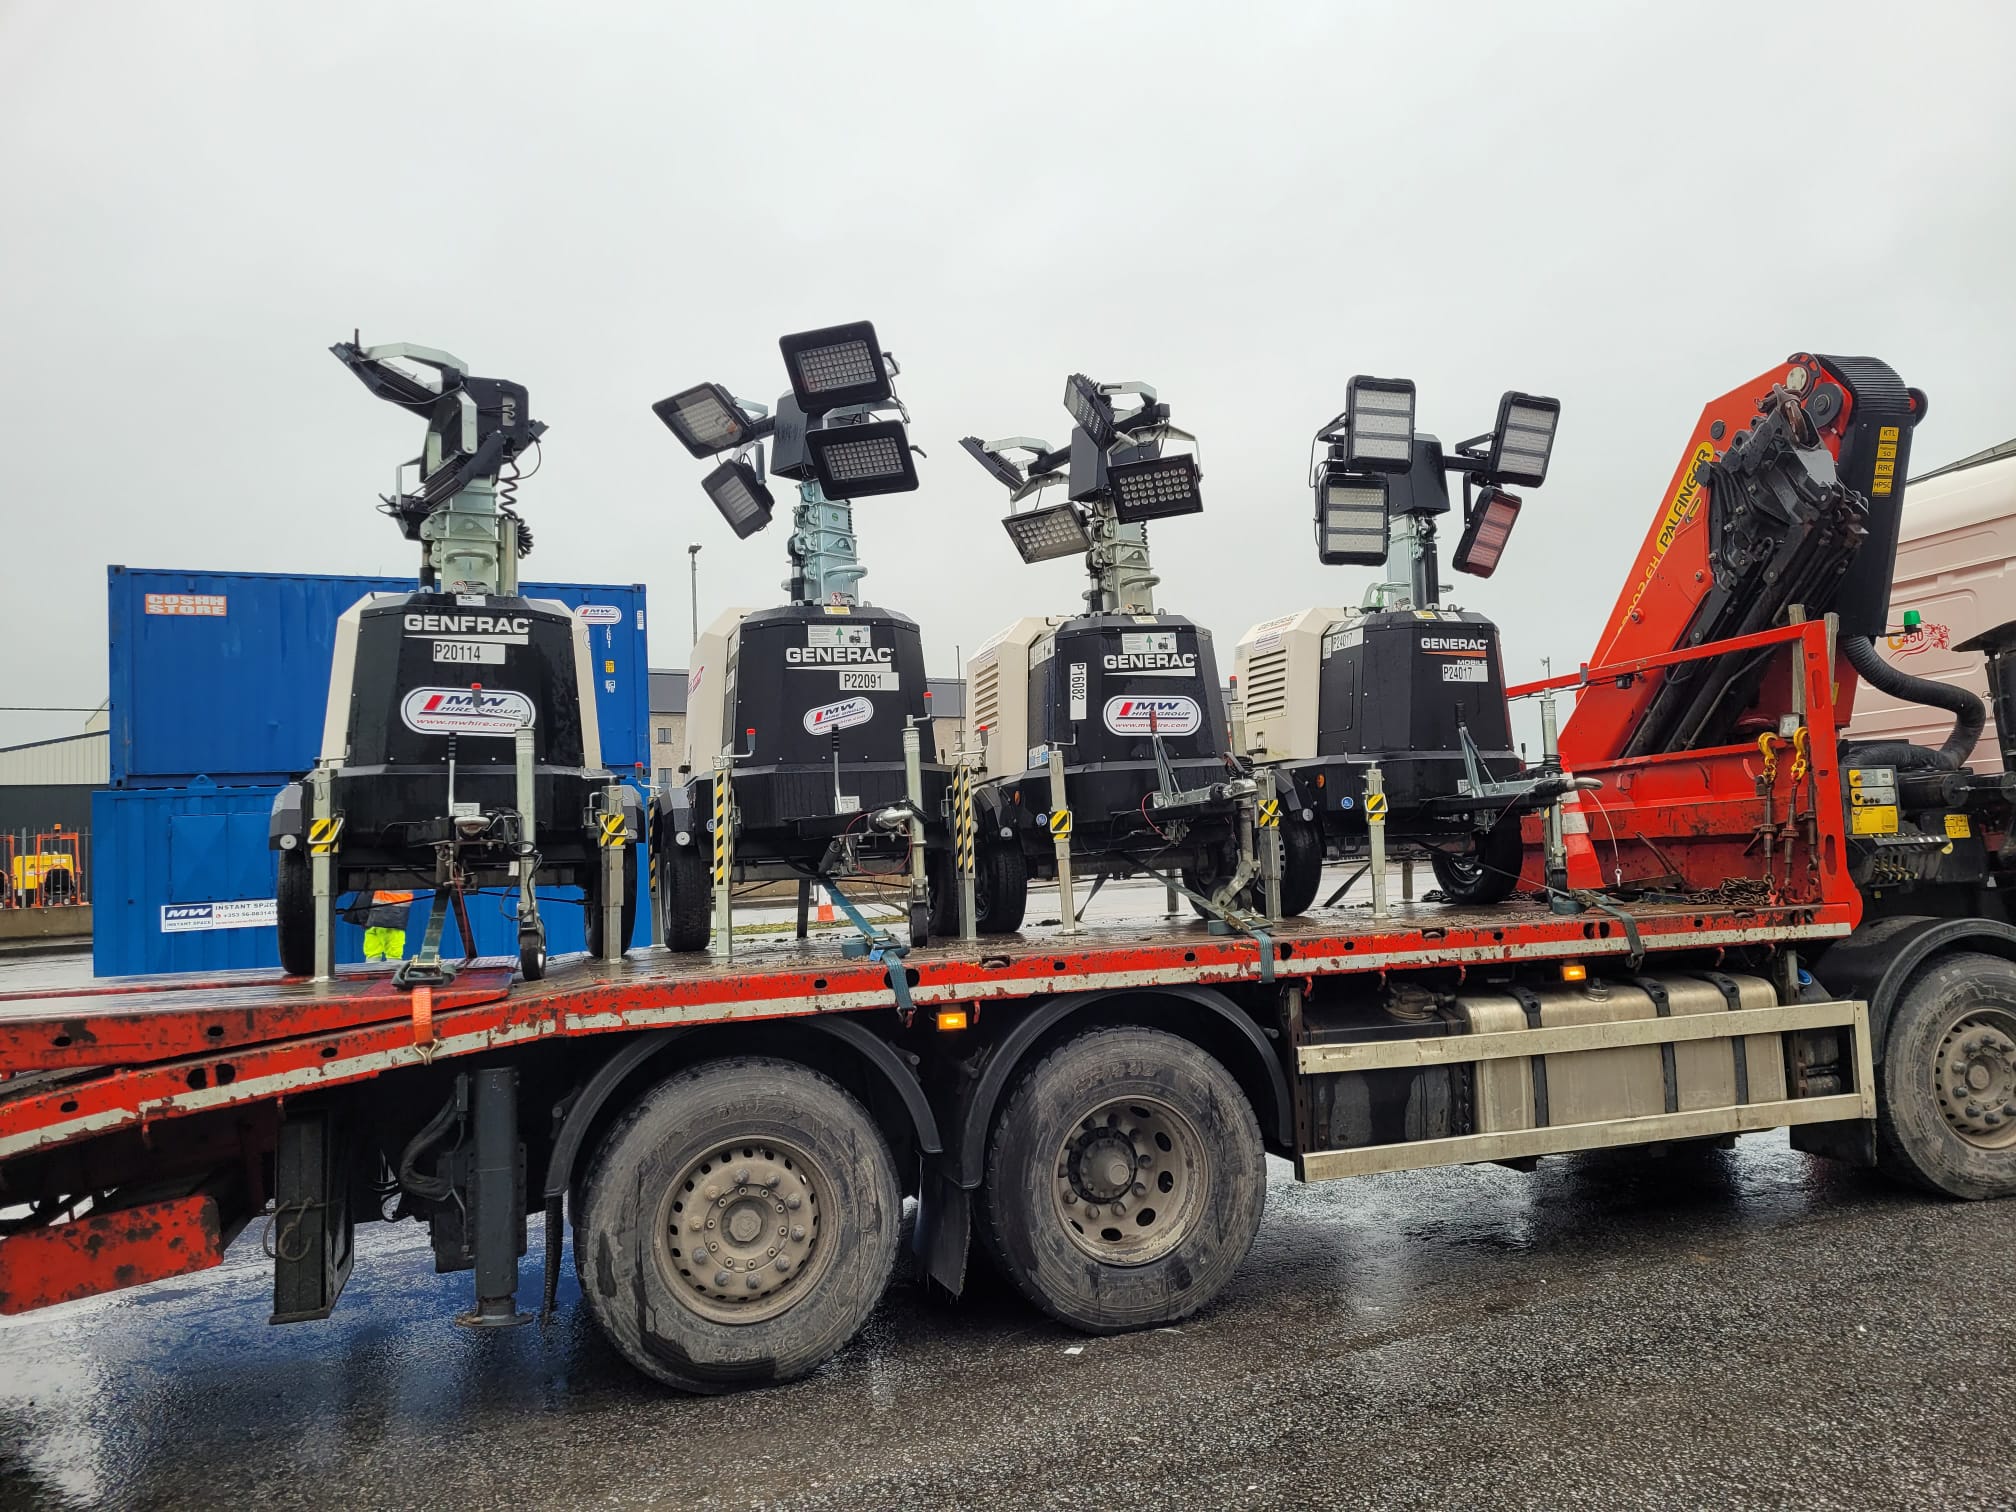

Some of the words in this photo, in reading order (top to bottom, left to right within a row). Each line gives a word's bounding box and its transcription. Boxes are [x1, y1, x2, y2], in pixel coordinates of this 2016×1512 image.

[147, 595, 225, 606] COSHH
[148, 604, 225, 615] STORE
[1421, 637, 1487, 650] GENERAC
[434, 643, 481, 662] P20114
[786, 647, 892, 663] GENERAC
[1103, 653, 1195, 669] GENERAC
[1443, 666, 1473, 681] P24017
[844, 673, 882, 689] P22091
[1071, 663, 1085, 701] P16082
[445, 695, 508, 706] MW
[1135, 702, 1180, 710] MW
[825, 702, 856, 716] MW
[416, 719, 517, 728] www.mwhire.com
[167, 907, 212, 918] MW
[215, 903, 251, 911] INSTANT
